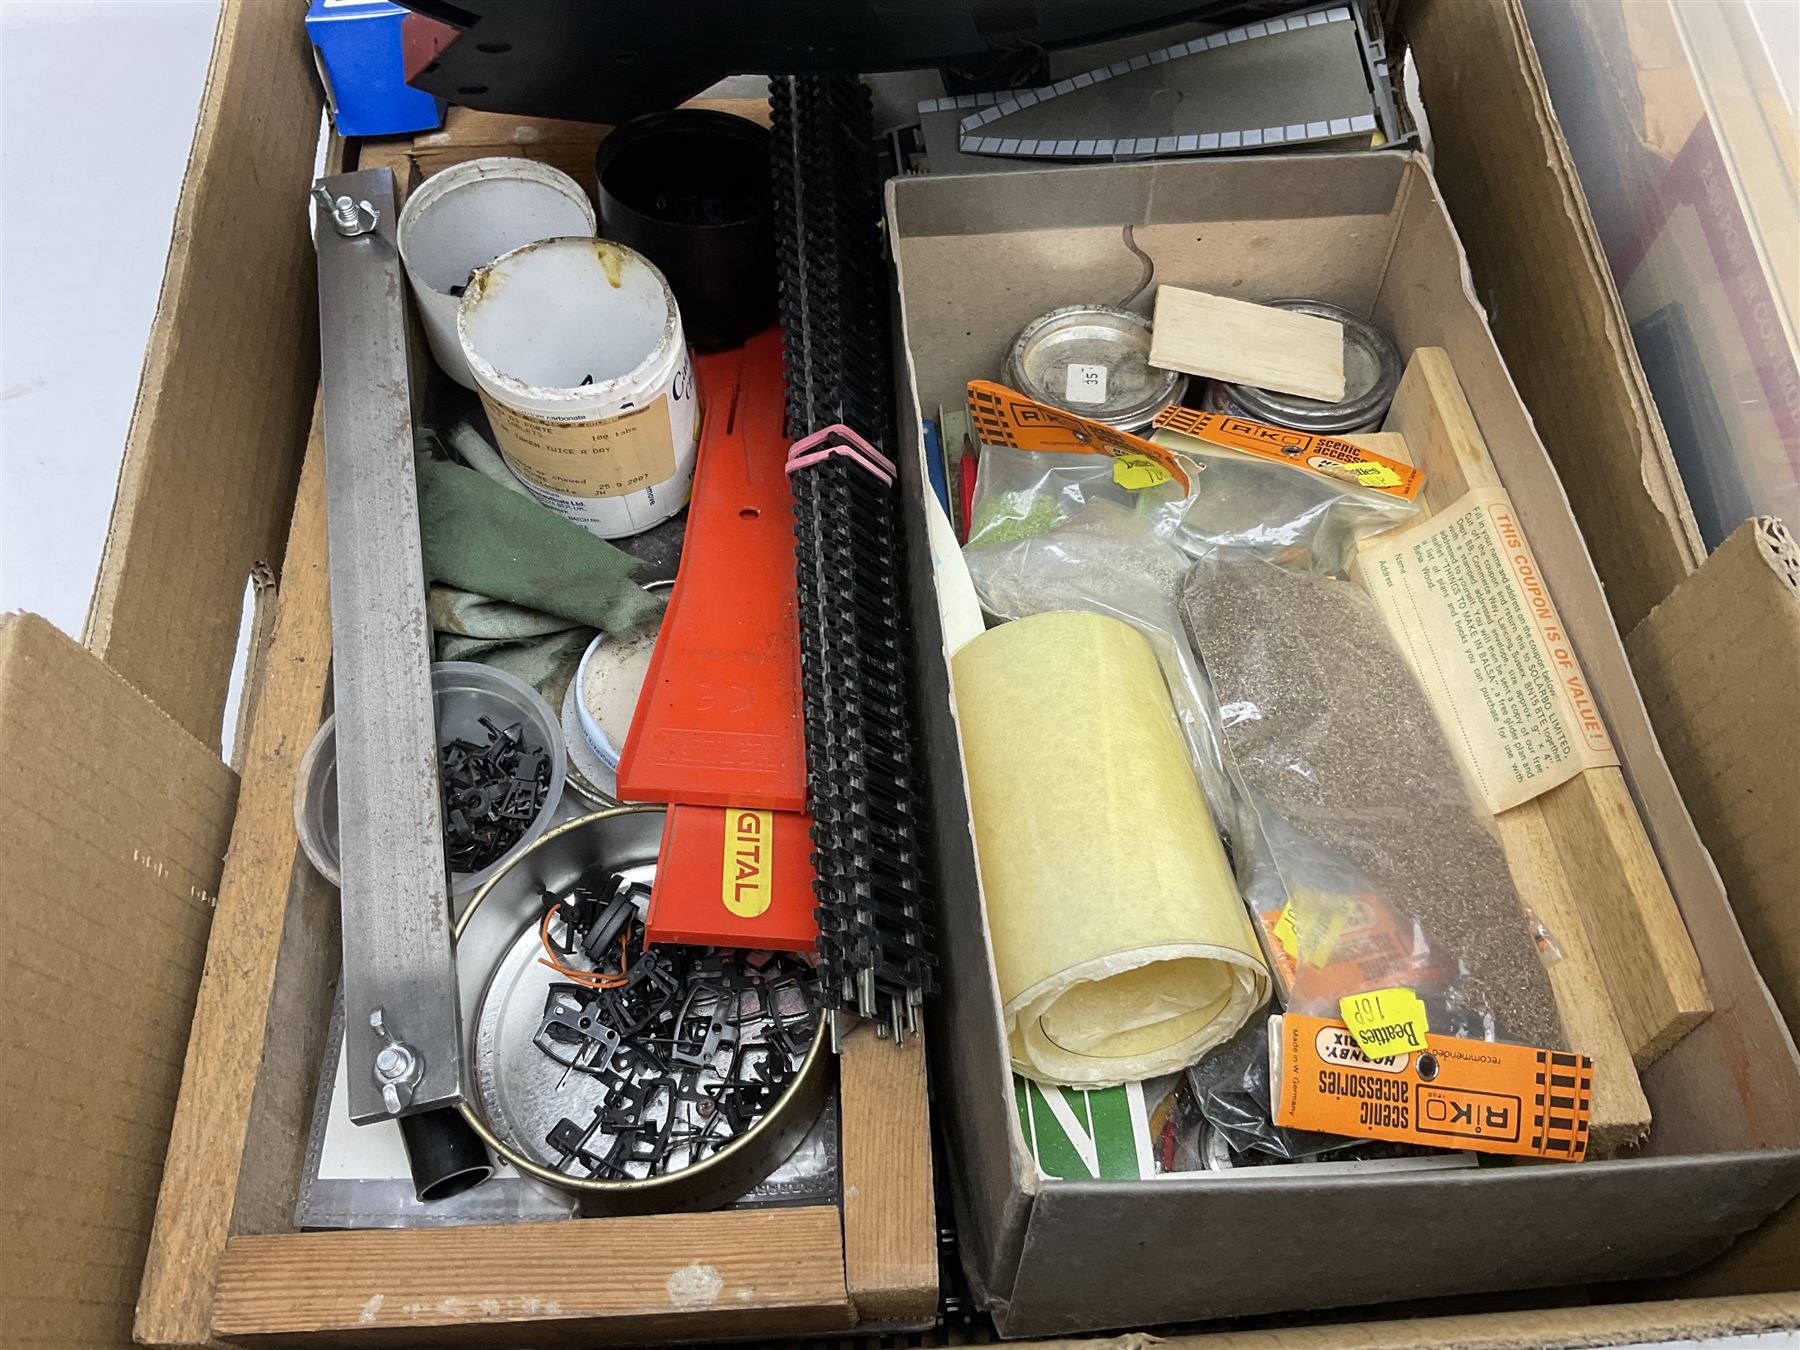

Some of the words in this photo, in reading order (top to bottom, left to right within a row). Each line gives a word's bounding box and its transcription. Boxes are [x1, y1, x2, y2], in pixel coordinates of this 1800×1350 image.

[546, 446, 575, 455] TWICE
[1316, 438, 1362, 457] scenic
[1471, 506, 1483, 519] Fill
[1477, 520, 1486, 528] in
[1480, 529, 1493, 547] your
[1394, 553, 1407, 574] Name
[1412, 544, 1425, 563] Balsa
[1489, 547, 1502, 568] name
[1377, 558, 1395, 588] Address
[1498, 568, 1509, 583] and
[1448, 524, 1459, 540] with
[1459, 553, 1476, 584] stamped
[1474, 588, 1493, 624] addressed
[1489, 628, 1510, 665] envelope,
[1507, 668, 1519, 685] size
[1496, 513, 1521, 550] THIS
[1513, 553, 1551, 621] COUPON
[1543, 623, 1561, 643] IS
[1553, 646, 1573, 671] OF
[1504, 583, 1521, 612] address
[1463, 512, 1475, 526] Cut
[1470, 528, 1480, 540] off
[1476, 543, 1487, 556] the
[1482, 559, 1499, 588] coupon
[1496, 590, 1507, 605] and
[1503, 607, 1518, 632] return
[1514, 634, 1527, 650] this
[1522, 652, 1531, 662] to
[1527, 663, 1552, 710] SOLARBO
[1517, 612, 1526, 624] on
[1522, 625, 1532, 638] the
[1425, 548, 1434, 560] list
[1437, 577, 1449, 598] plans
[1447, 602, 1457, 616] and
[1454, 619, 1469, 644] books
[1464, 647, 1476, 664] you
[1473, 667, 1483, 682] can
[1481, 686, 1499, 722] purchase
[1497, 726, 1507, 739] for
[1504, 744, 1513, 758] use
[1511, 762, 1523, 783] with
[1430, 534, 1444, 557] leaflet
[1455, 596, 1466, 609] TO
[1461, 611, 1477, 637] MAKE
[1473, 639, 1482, 650] IN
[1497, 698, 1509, 715] free
[1504, 716, 1519, 741] glider
[1514, 741, 1527, 761] plan
[1522, 761, 1534, 778] and
[1439, 530, 1457, 563] addressed
[1454, 565, 1462, 574] to
[1472, 609, 1484, 626] You
[1479, 628, 1490, 643] will
[1486, 645, 1498, 662] then
[1494, 664, 1504, 675] be
[1500, 677, 1511, 694] sent
[1509, 703, 1523, 725] copy
[1520, 726, 1528, 737] of
[1525, 739, 1535, 754] our
[1532, 756, 1544, 774] free
[1471, 554, 1492, 594] Commerce
[1523, 681, 1539, 706] BN15
[1541, 727, 1562, 764] together
[1527, 639, 1545, 670] coupon
[1291, 1029, 1299, 1052] Made
[1359, 1020, 1420, 1049] Beatties
[1288, 1077, 1299, 1117] Germany
[1318, 1069, 1410, 1103] accessories
[1360, 1101, 1410, 1131] scenic
